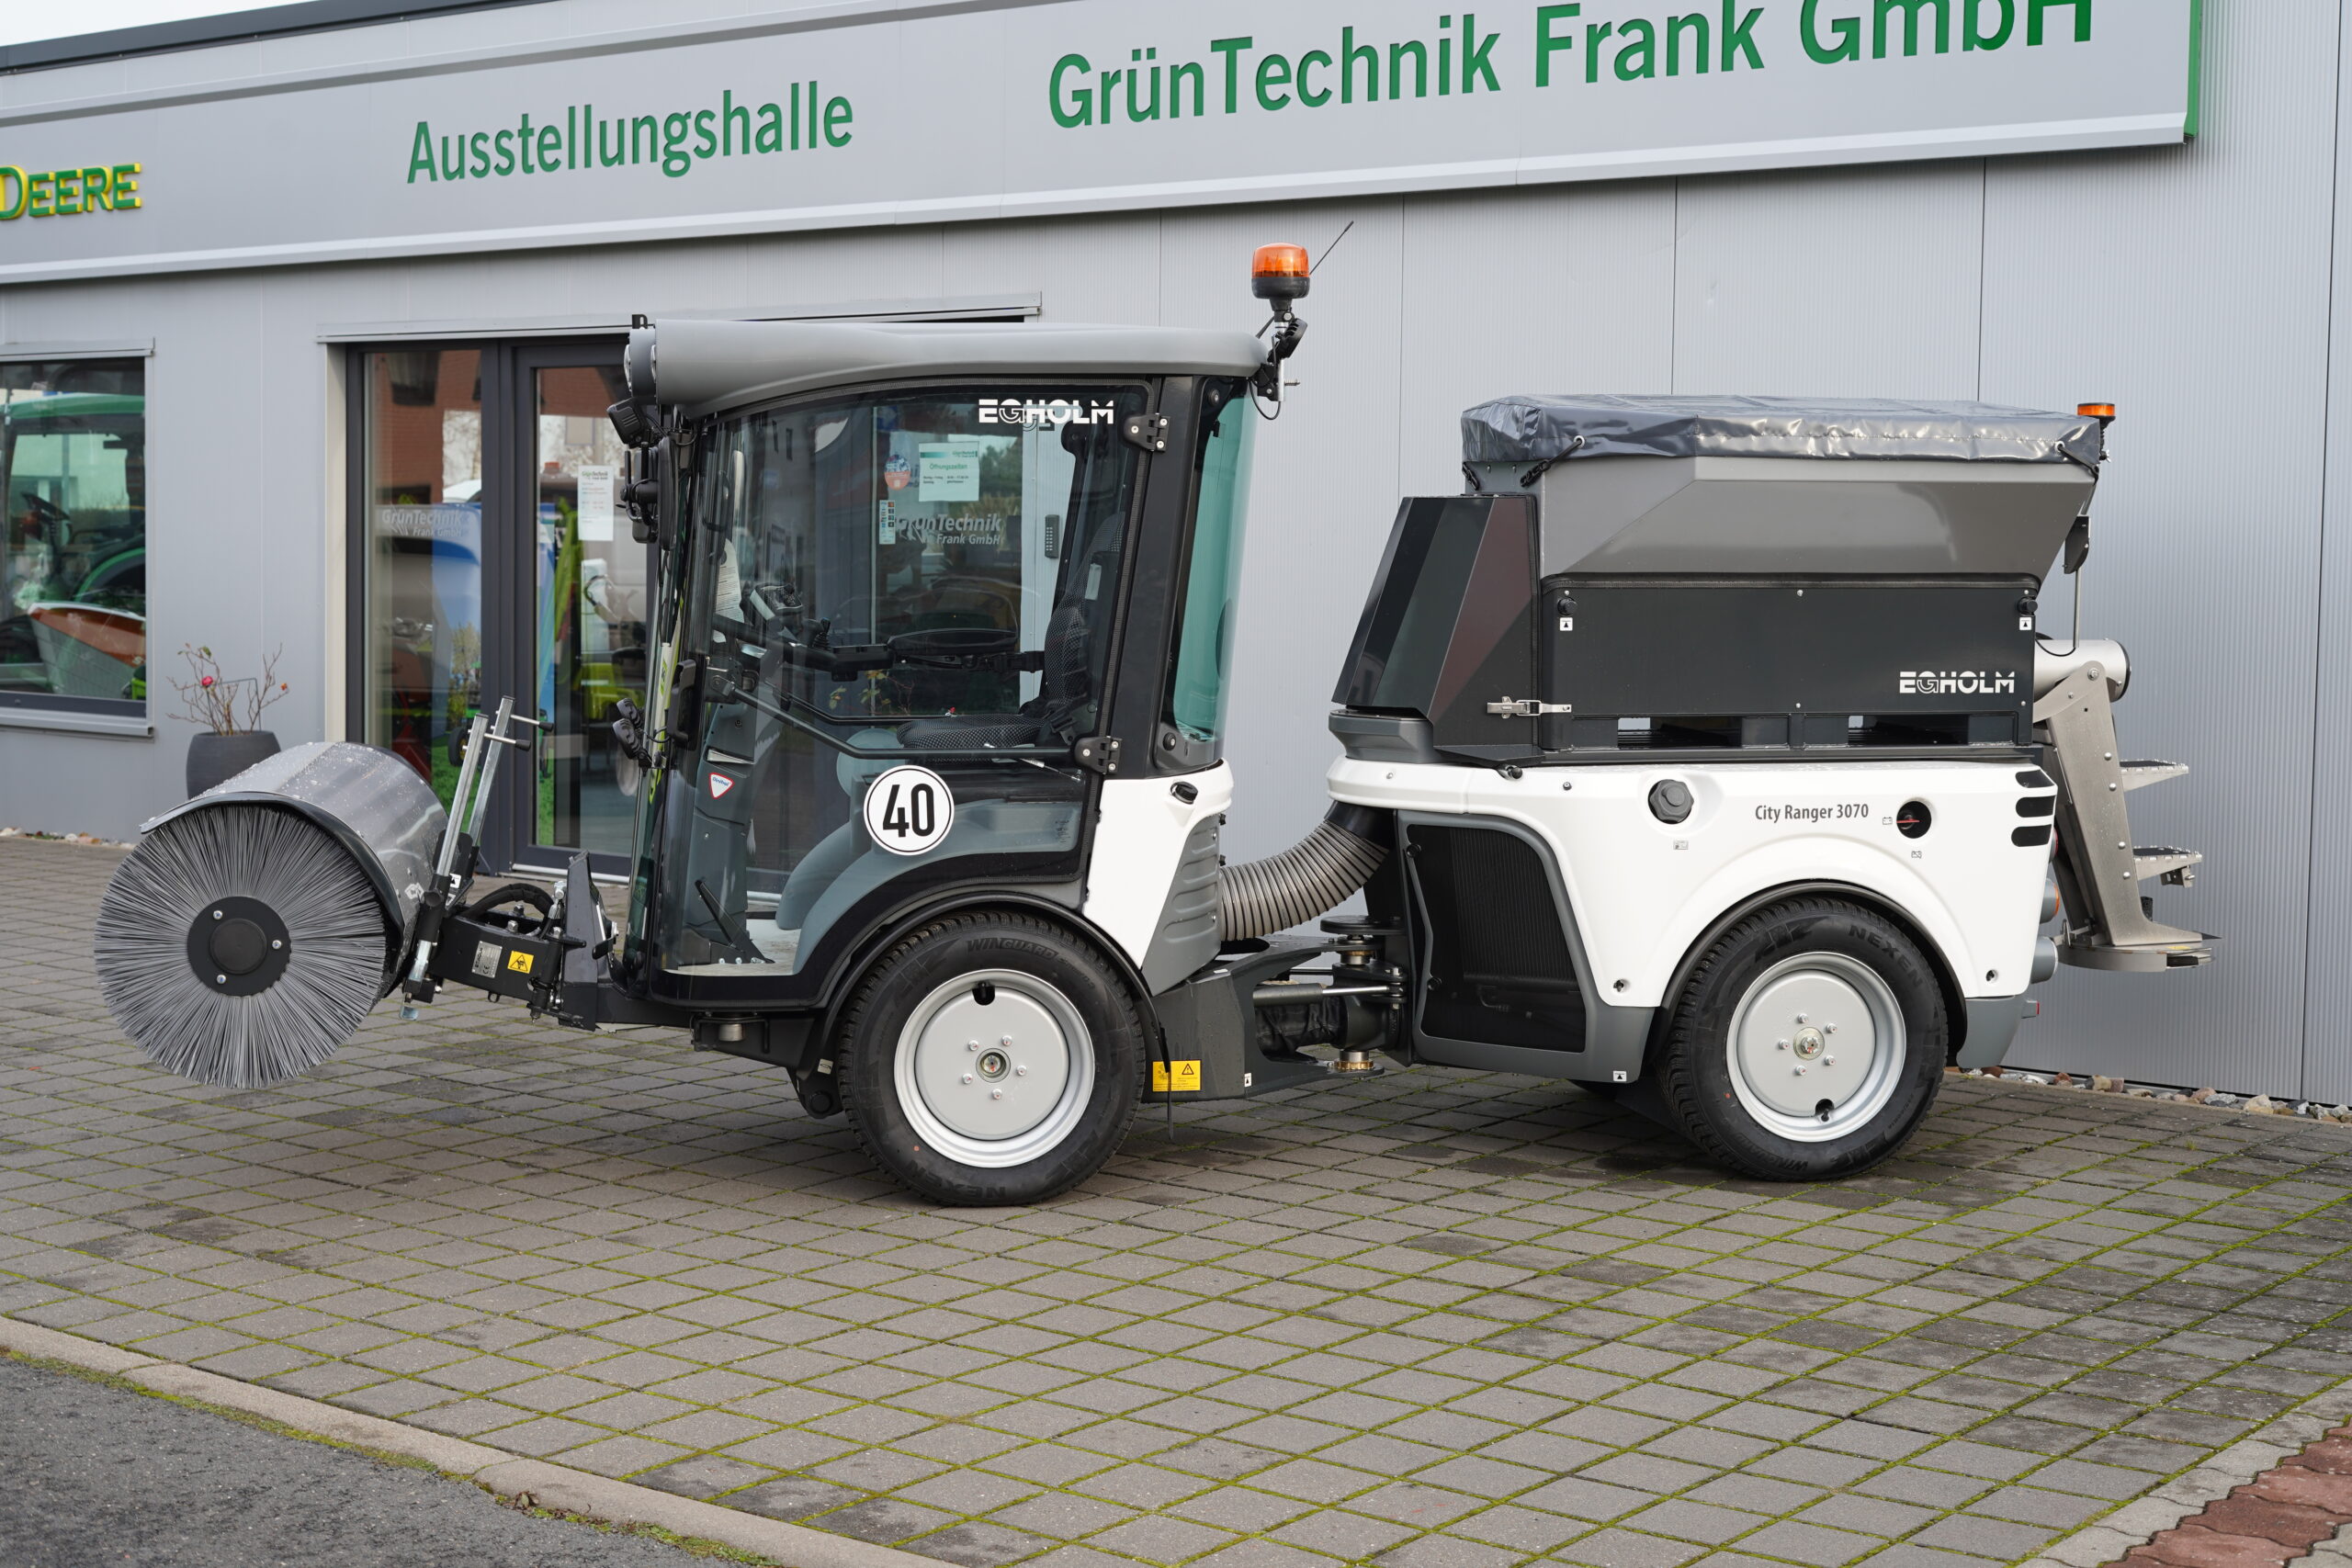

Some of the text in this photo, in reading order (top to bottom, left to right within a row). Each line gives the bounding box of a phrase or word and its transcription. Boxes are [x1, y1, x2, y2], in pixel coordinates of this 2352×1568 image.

[1049, 13, 1501, 129] GrünTechnik
[1535, 0, 1765, 88] Frank
[407, 81, 854, 184] Ausstellungshalle
[0, 163, 141, 220] DEERE
[978, 399, 1114, 424] EGHOLM
[937, 534, 1001, 545] Frank GmbH
[1899, 671, 2015, 694] EGHOLM
[883, 784, 935, 838] 40
[1755, 804, 1869, 823] City Ranger 3070
[967, 938, 1058, 960] WINGUARD
[1849, 925, 1923, 987] NEXEN
